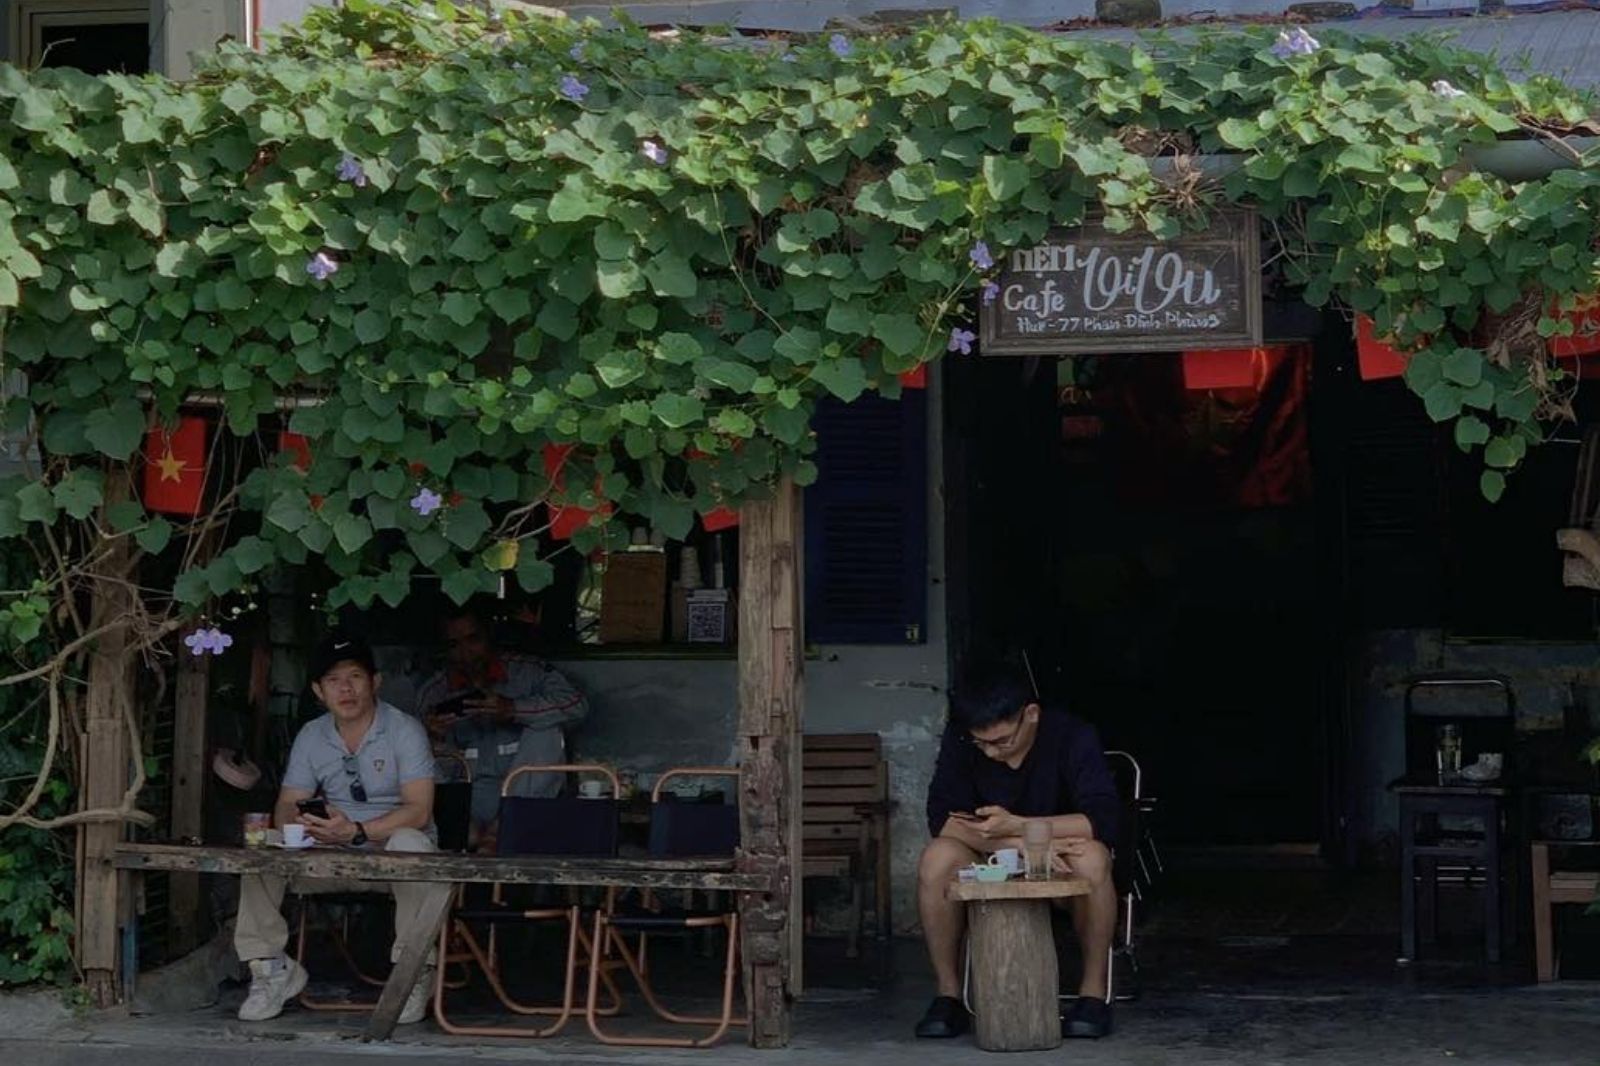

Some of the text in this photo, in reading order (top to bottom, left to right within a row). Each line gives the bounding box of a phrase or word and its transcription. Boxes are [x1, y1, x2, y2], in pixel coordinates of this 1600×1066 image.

[1003, 280, 1065, 318] Cafe
[1058, 318, 1080, 332] 77
[1084, 316, 1120, 331] Phan
